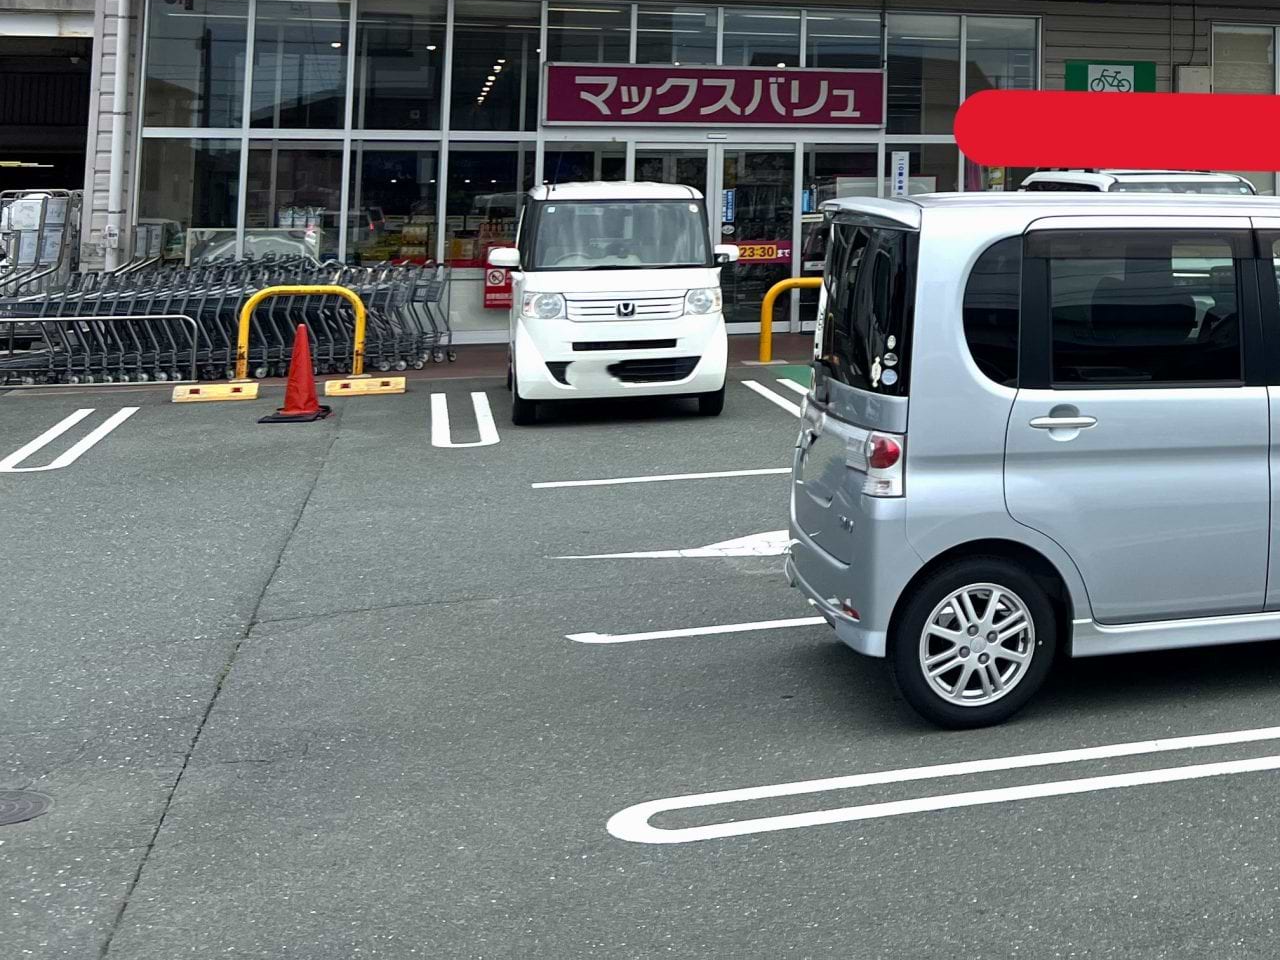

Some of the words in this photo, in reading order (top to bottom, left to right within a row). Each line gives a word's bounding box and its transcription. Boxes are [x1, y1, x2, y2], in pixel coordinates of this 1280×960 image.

[575, 76, 861, 118] マックスバリュ
